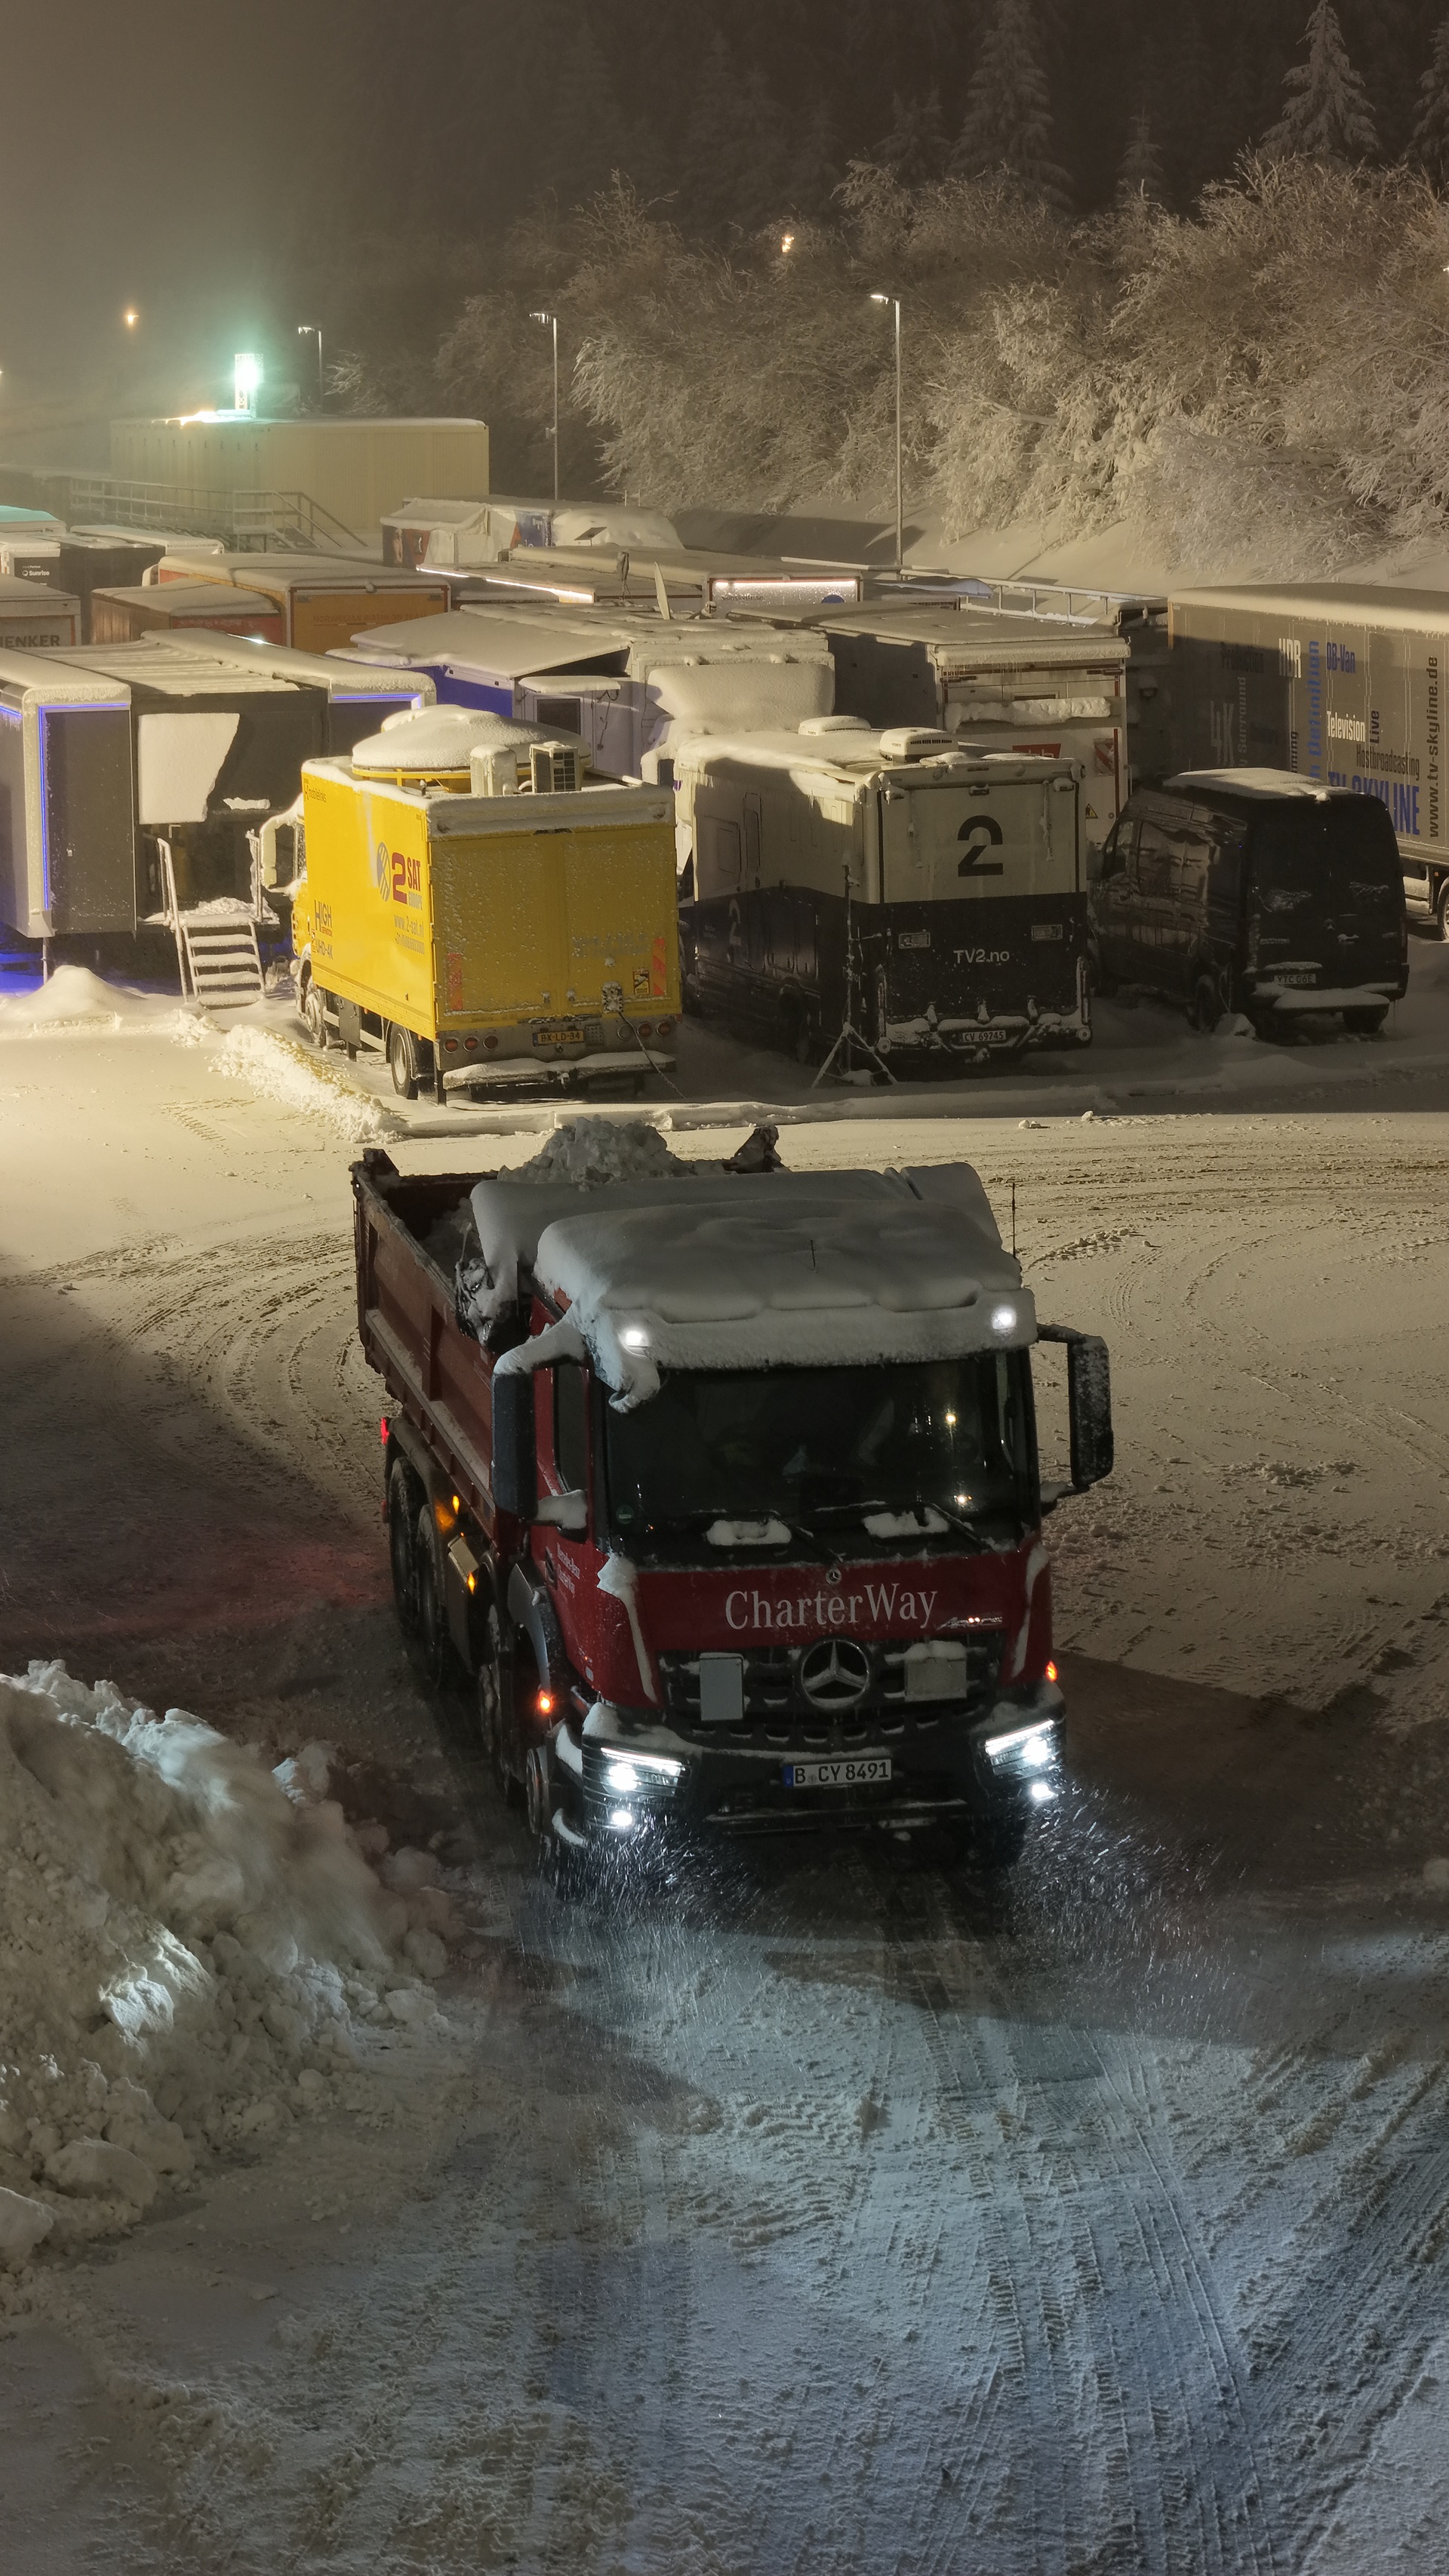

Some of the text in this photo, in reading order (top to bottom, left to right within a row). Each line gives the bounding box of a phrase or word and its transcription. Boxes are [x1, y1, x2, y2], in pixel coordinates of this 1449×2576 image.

[313, 615, 361, 623] NORWEGIAN
[1278, 638, 1302, 679] HDR
[1326, 642, 1356, 674] OB-Van
[1210, 700, 1235, 768] 4K
[1326, 710, 1366, 743] Television
[1369, 710, 1380, 744] Live
[1355, 744, 1420, 781] Hostbroadcasting
[1426, 656, 1440, 838] www.tv-skyline.de
[957, 814, 1004, 877] 2
[391, 851, 422, 906] 2 SAT
[314, 899, 333, 933] HIGH
[728, 898, 742, 947] 2
[953, 948, 1010, 964] TV2.no
[1276, 975, 1294, 983] YTC
[541, 1032, 580, 1042] BX-LD-34
[964, 1031, 1004, 1042] CV 69745
[724, 1582, 938, 1630] CharterWay
[795, 1762, 889, 1784] B CY 8491
